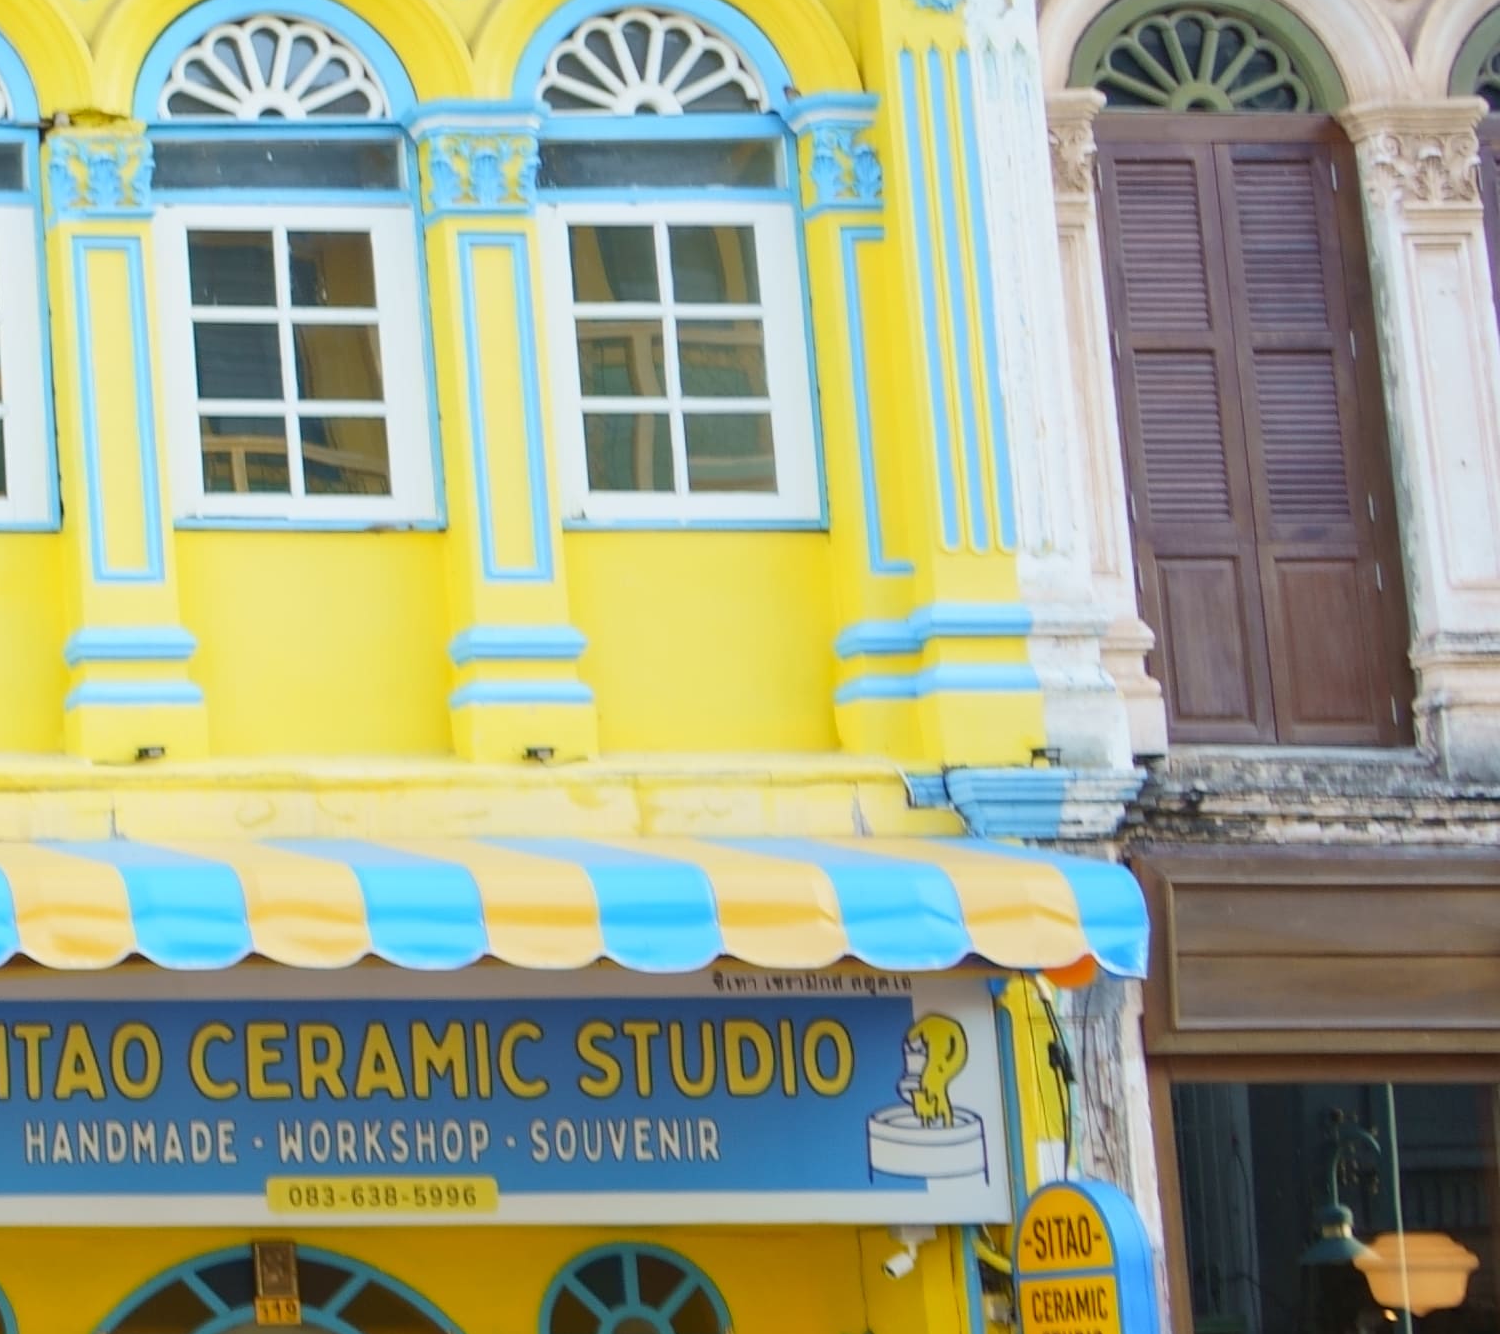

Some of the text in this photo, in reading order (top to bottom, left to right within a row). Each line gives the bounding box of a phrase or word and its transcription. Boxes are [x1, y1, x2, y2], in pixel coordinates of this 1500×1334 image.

[187, 1019, 547, 1101] CERAMIC
[576, 1017, 856, 1099] STUDIO
[25, 1117, 721, 1164] HANDMADE WORKSHOP SOUVENIR
[288, 1184, 477, 1209] 083-638-5996
[1031, 1285, 1109, 1324] CERAMIC
